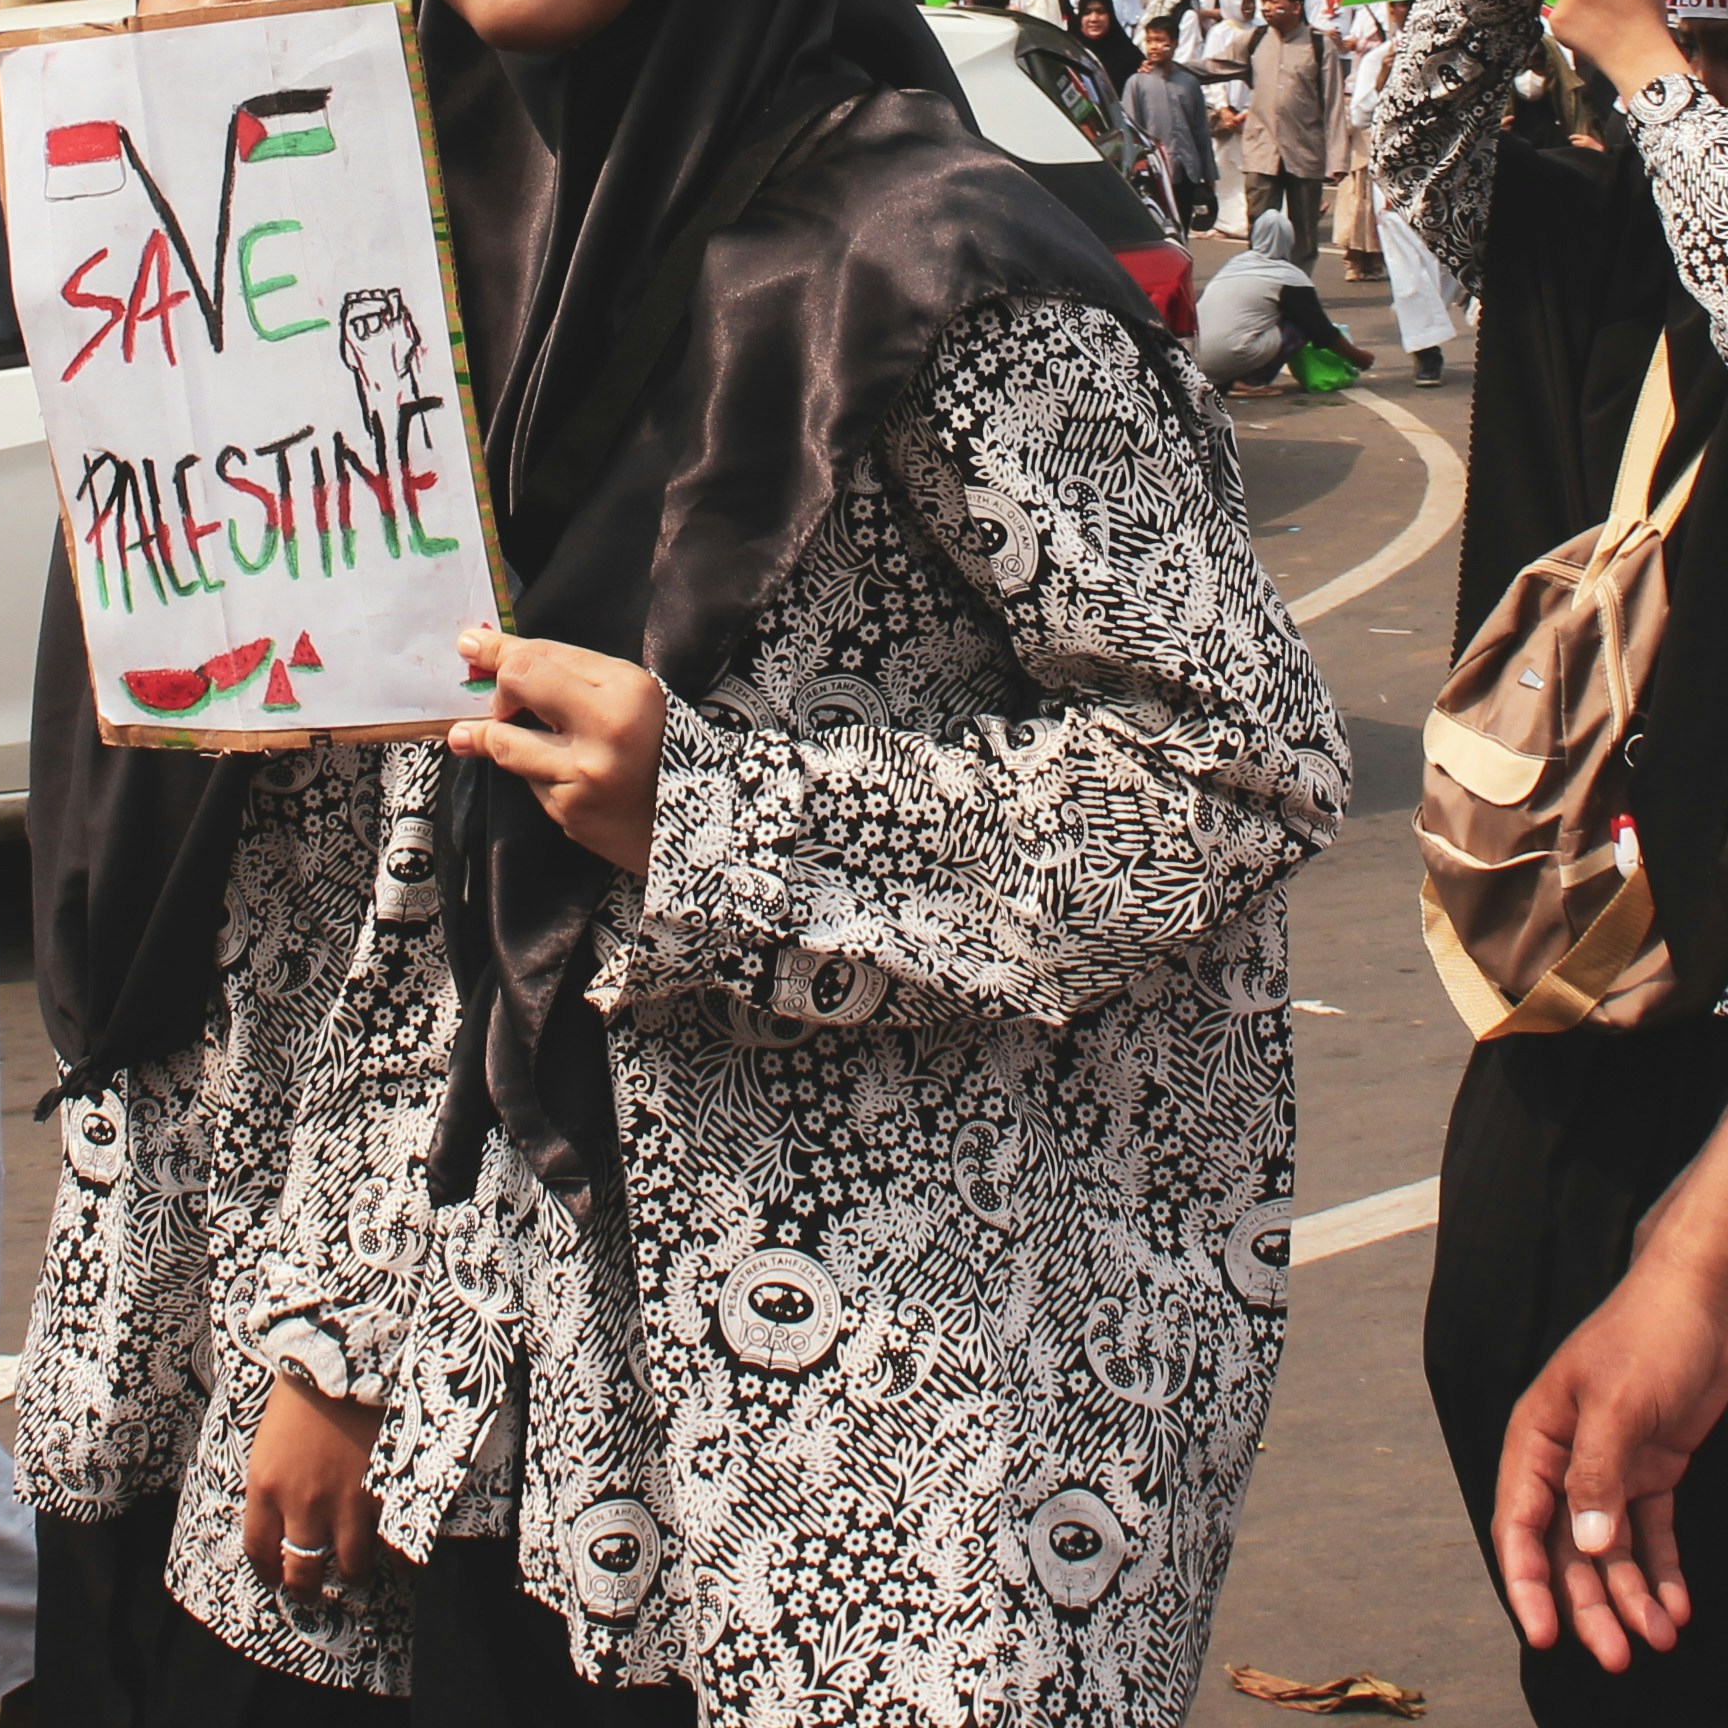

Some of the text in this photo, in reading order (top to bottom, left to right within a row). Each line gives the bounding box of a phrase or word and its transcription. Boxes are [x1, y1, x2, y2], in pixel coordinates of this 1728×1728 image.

[61, 106, 332, 382] SAVE
[77, 397, 460, 613] PALESTINE
[727, 1261, 768, 1317] PESANTREN
[772, 1256, 817, 1279] TAHFIZH
[739, 1321, 810, 1355] IQRO
